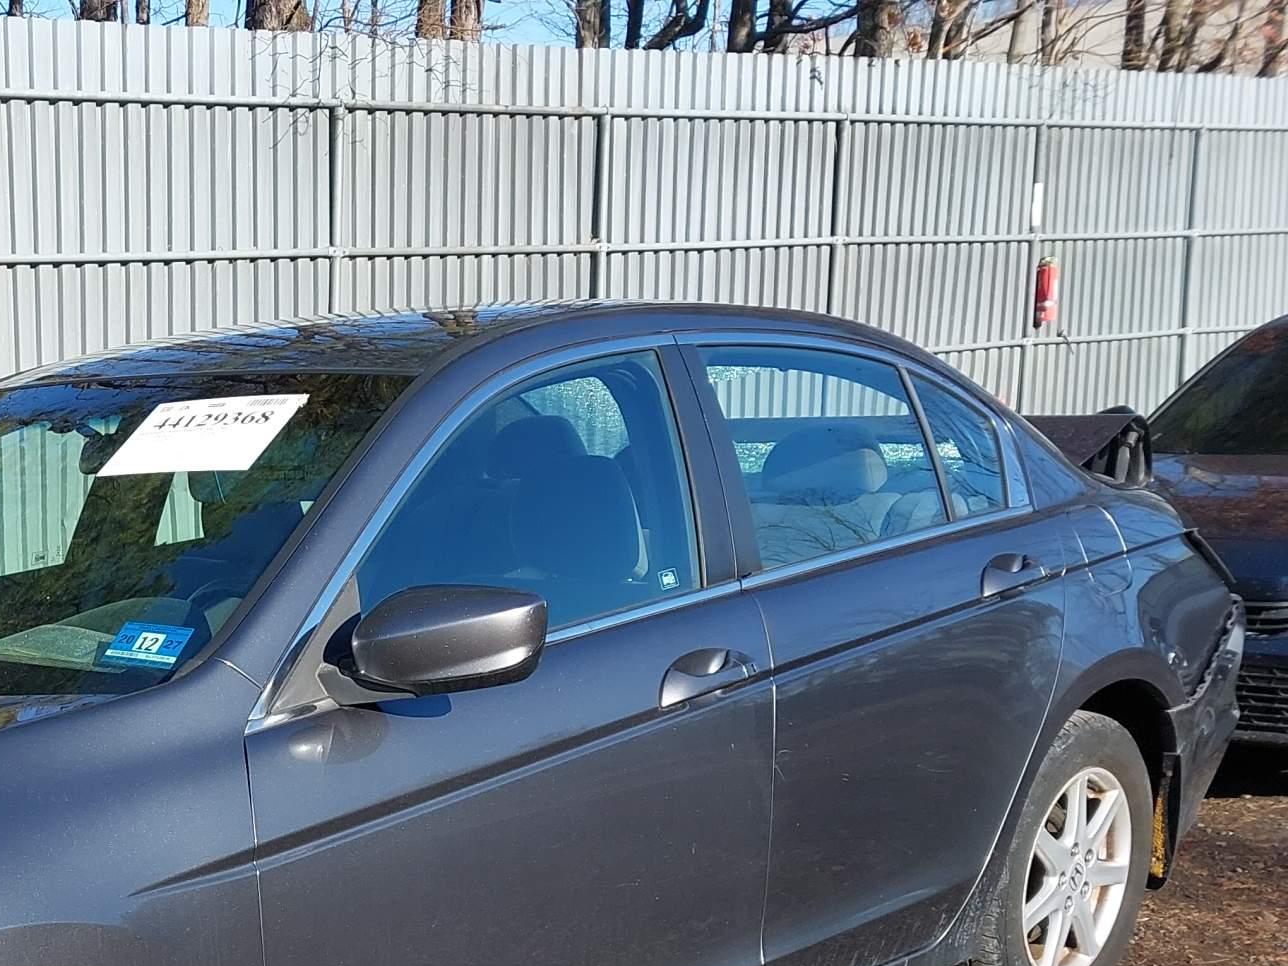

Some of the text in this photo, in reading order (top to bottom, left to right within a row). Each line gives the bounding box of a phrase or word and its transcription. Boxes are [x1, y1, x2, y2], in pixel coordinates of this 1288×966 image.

[153, 410, 275, 430] 44129368
[118, 633, 183, 651] 20 12 27
